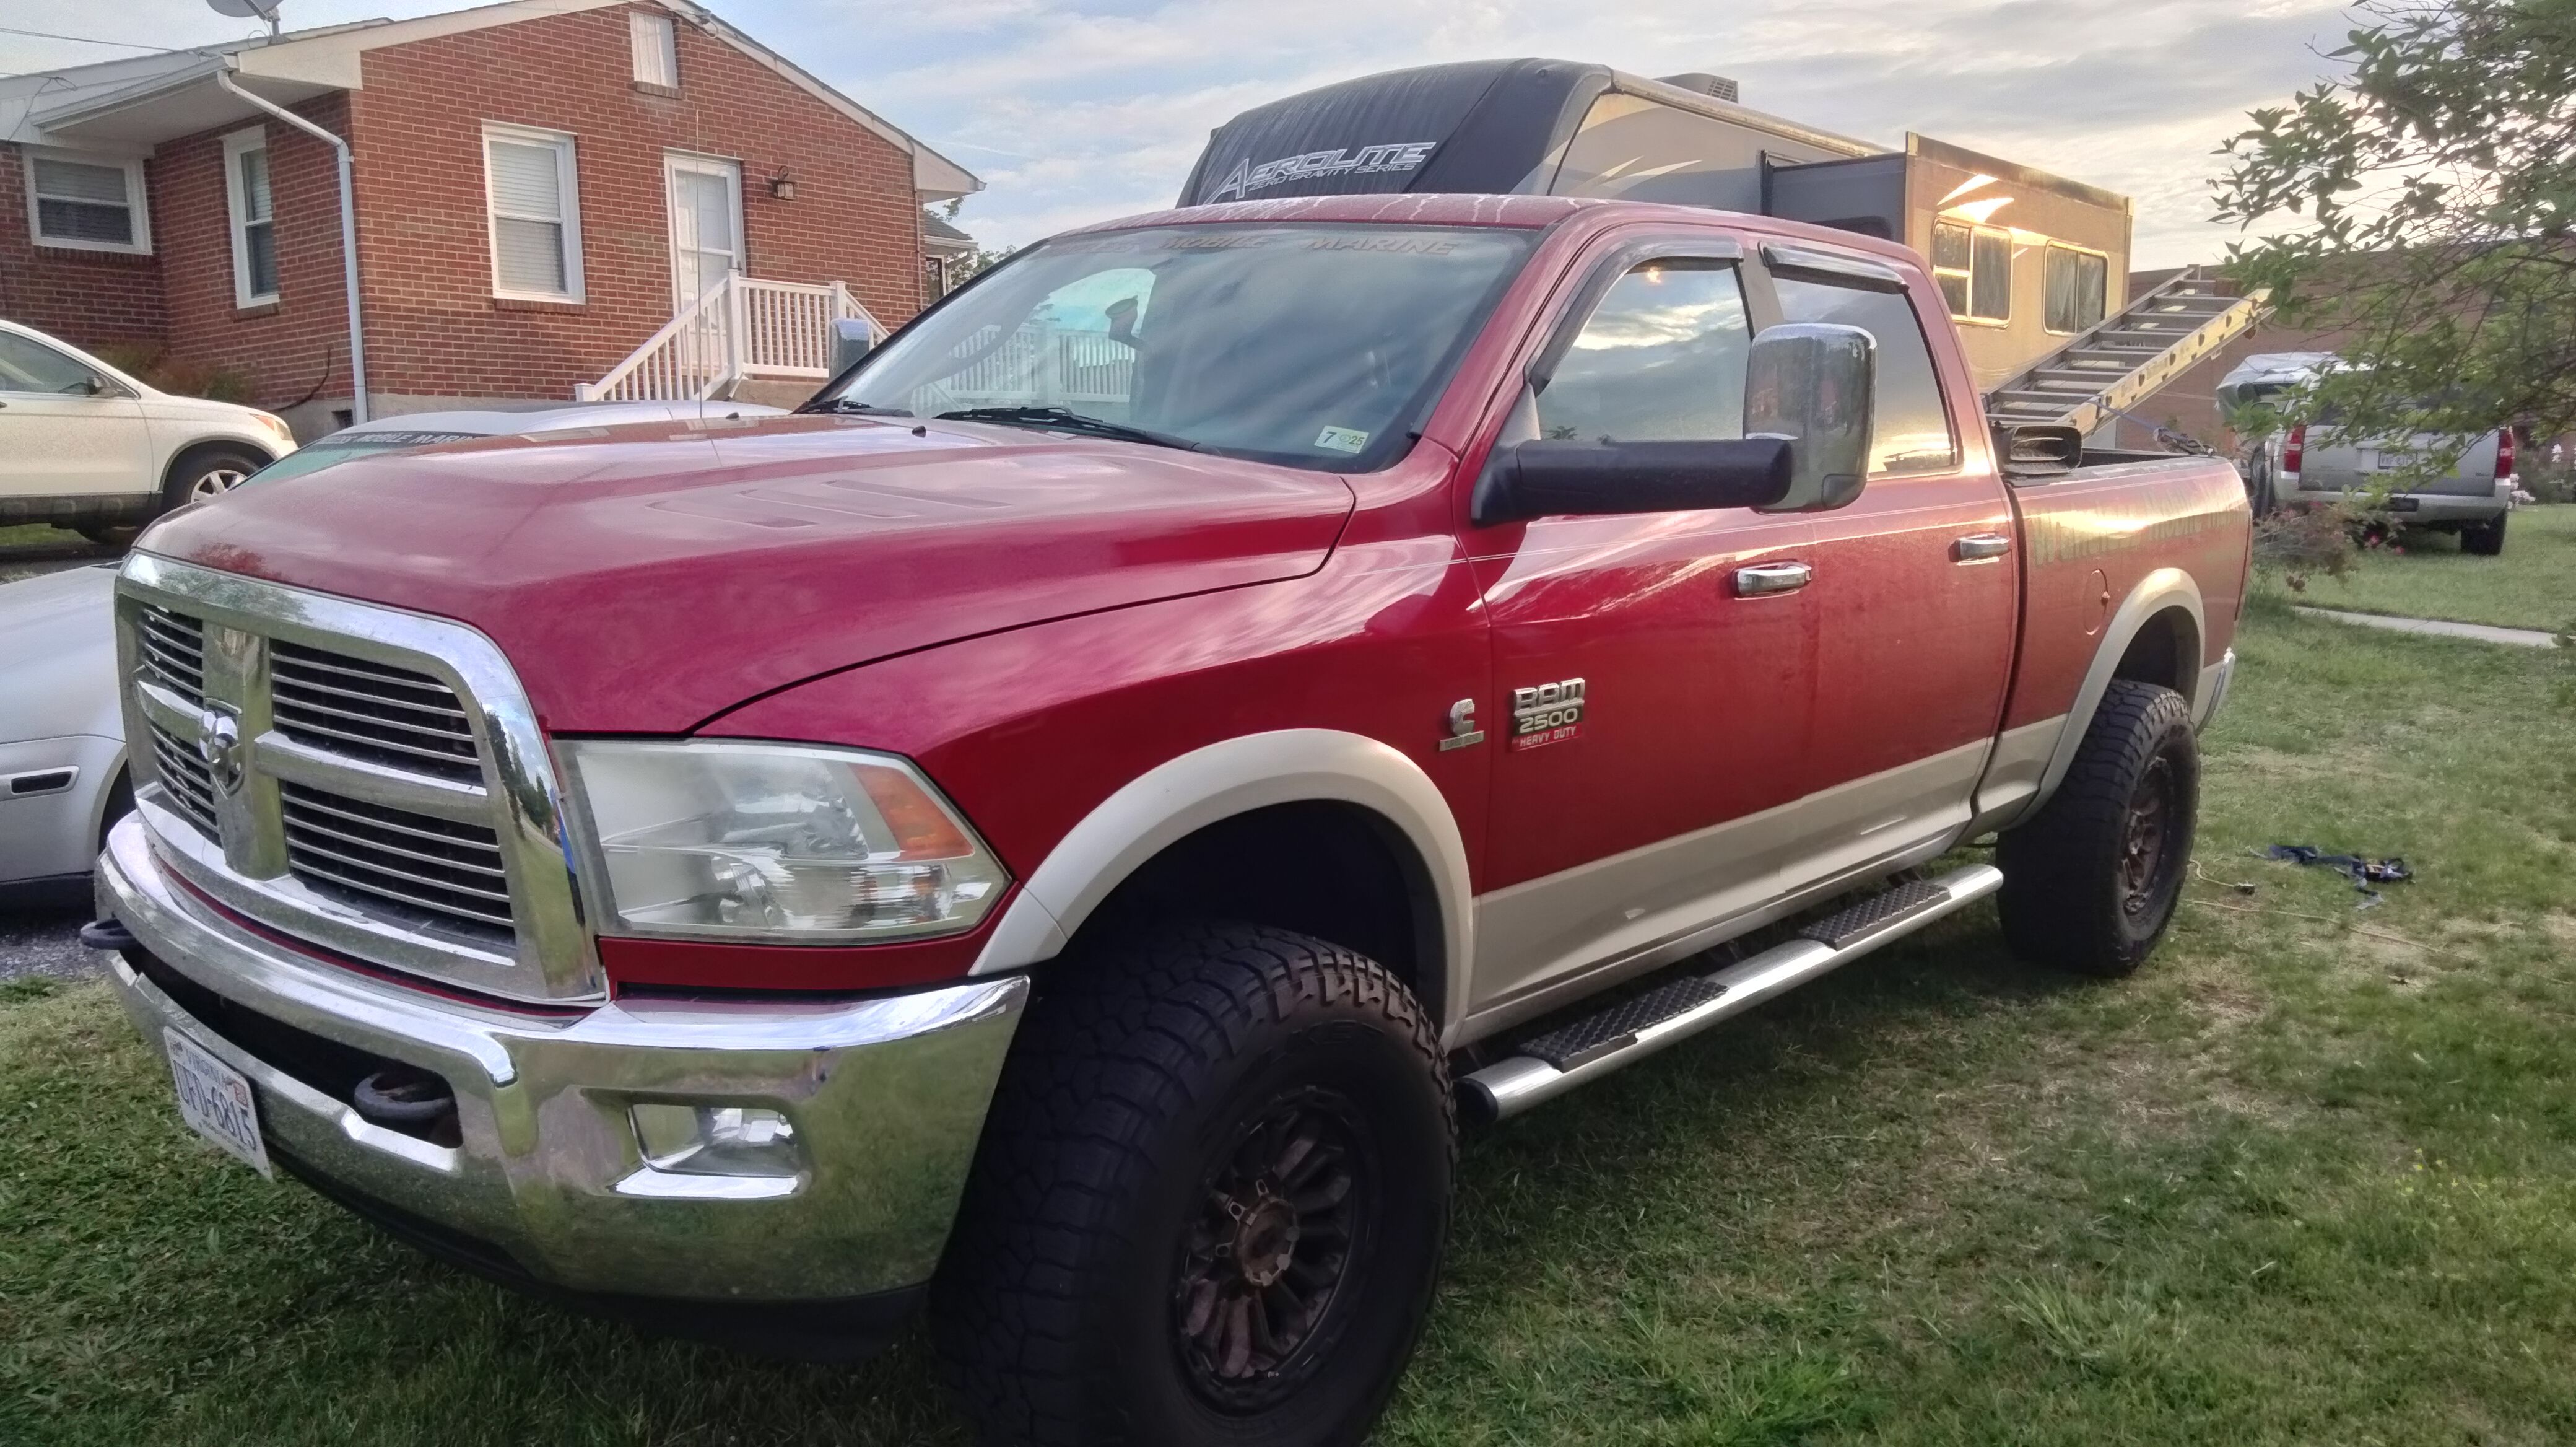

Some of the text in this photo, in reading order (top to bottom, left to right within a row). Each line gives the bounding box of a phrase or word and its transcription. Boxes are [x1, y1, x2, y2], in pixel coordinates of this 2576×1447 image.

[1204, 142, 1437, 206] AEROLITE
[1248, 163, 1417, 192] ZERO GRAVITY SERIES
[1158, 235, 1273, 249] MOBILE
[1305, 237, 1460, 255] MARINE
[1323, 431, 1365, 445] 7 25
[1513, 678, 1585, 714] RAM
[1519, 708, 1578, 733] 2500
[1520, 732, 1551, 747] HEAVY
[1554, 726, 1577, 740] DUTY
